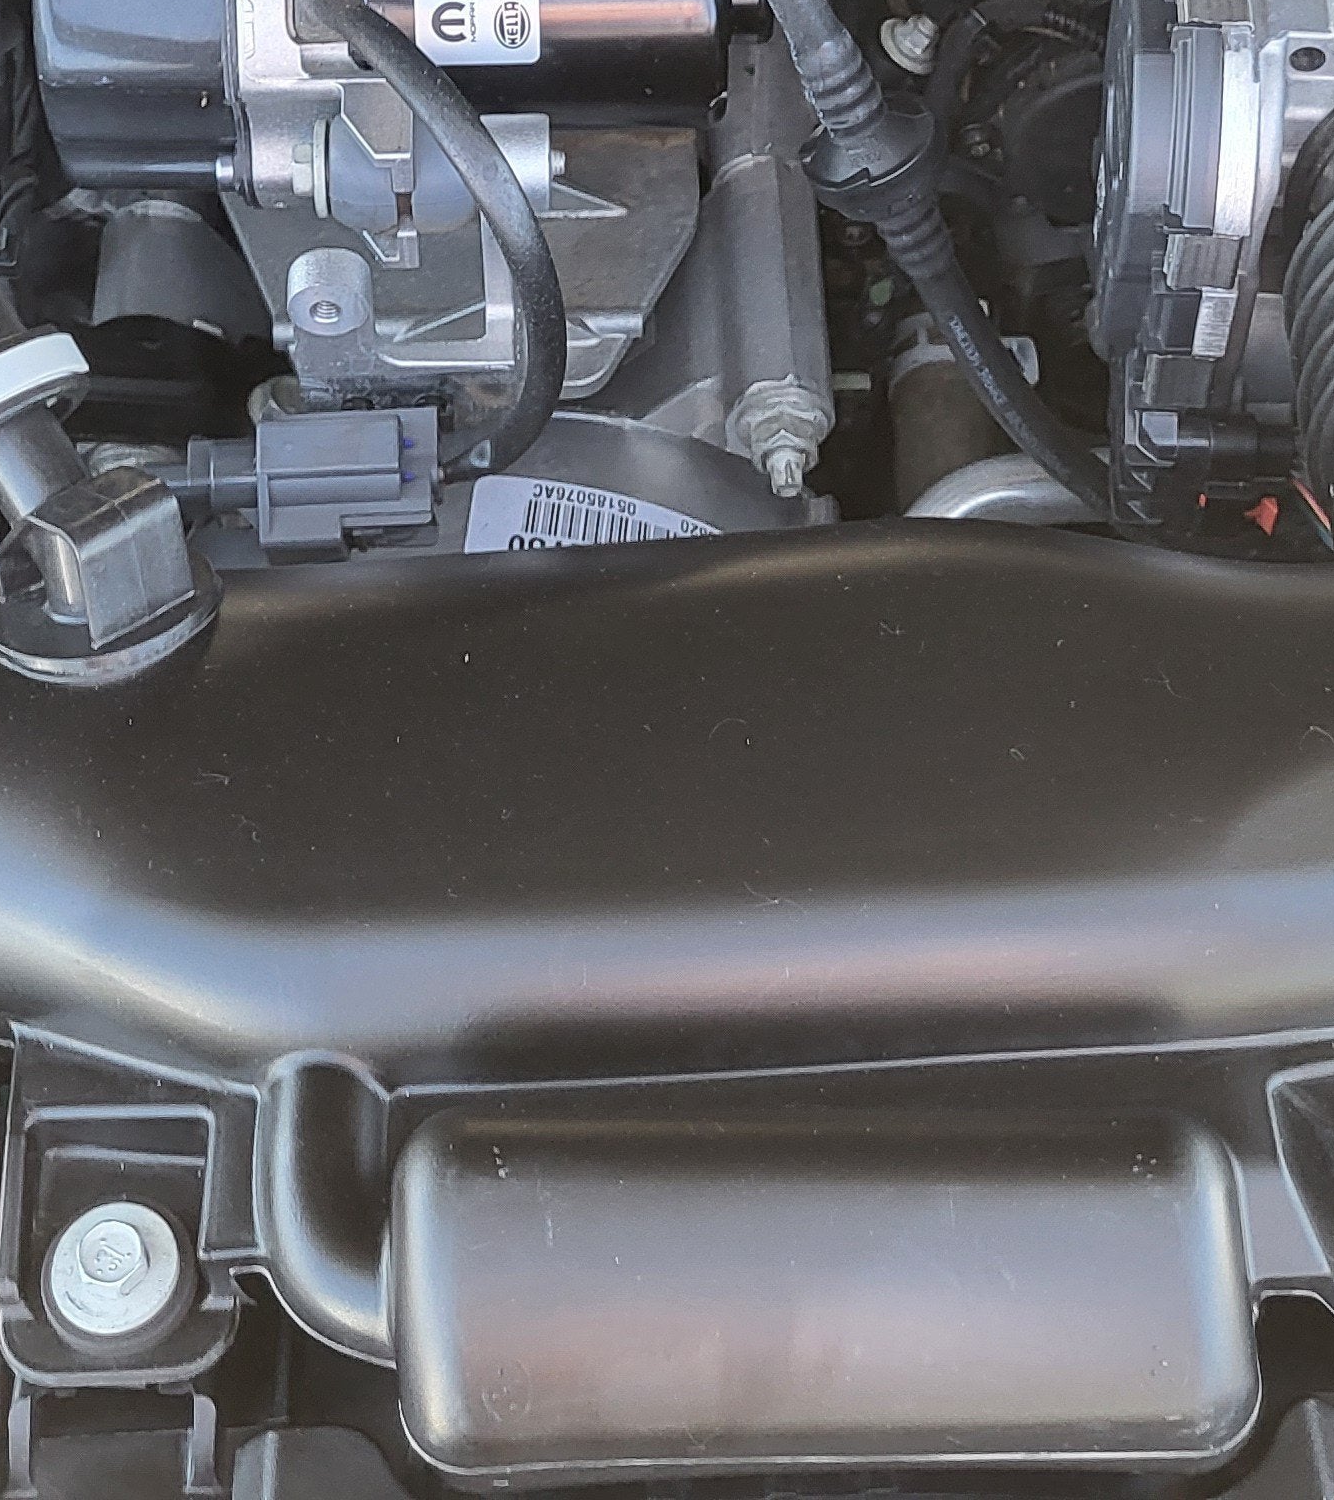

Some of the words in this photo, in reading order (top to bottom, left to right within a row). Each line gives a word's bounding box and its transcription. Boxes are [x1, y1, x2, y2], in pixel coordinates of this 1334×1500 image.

[469, 1, 477, 43] MOPAR
[503, 1, 520, 47] HELLA
[532, 483, 637, 517] 05185076AC
